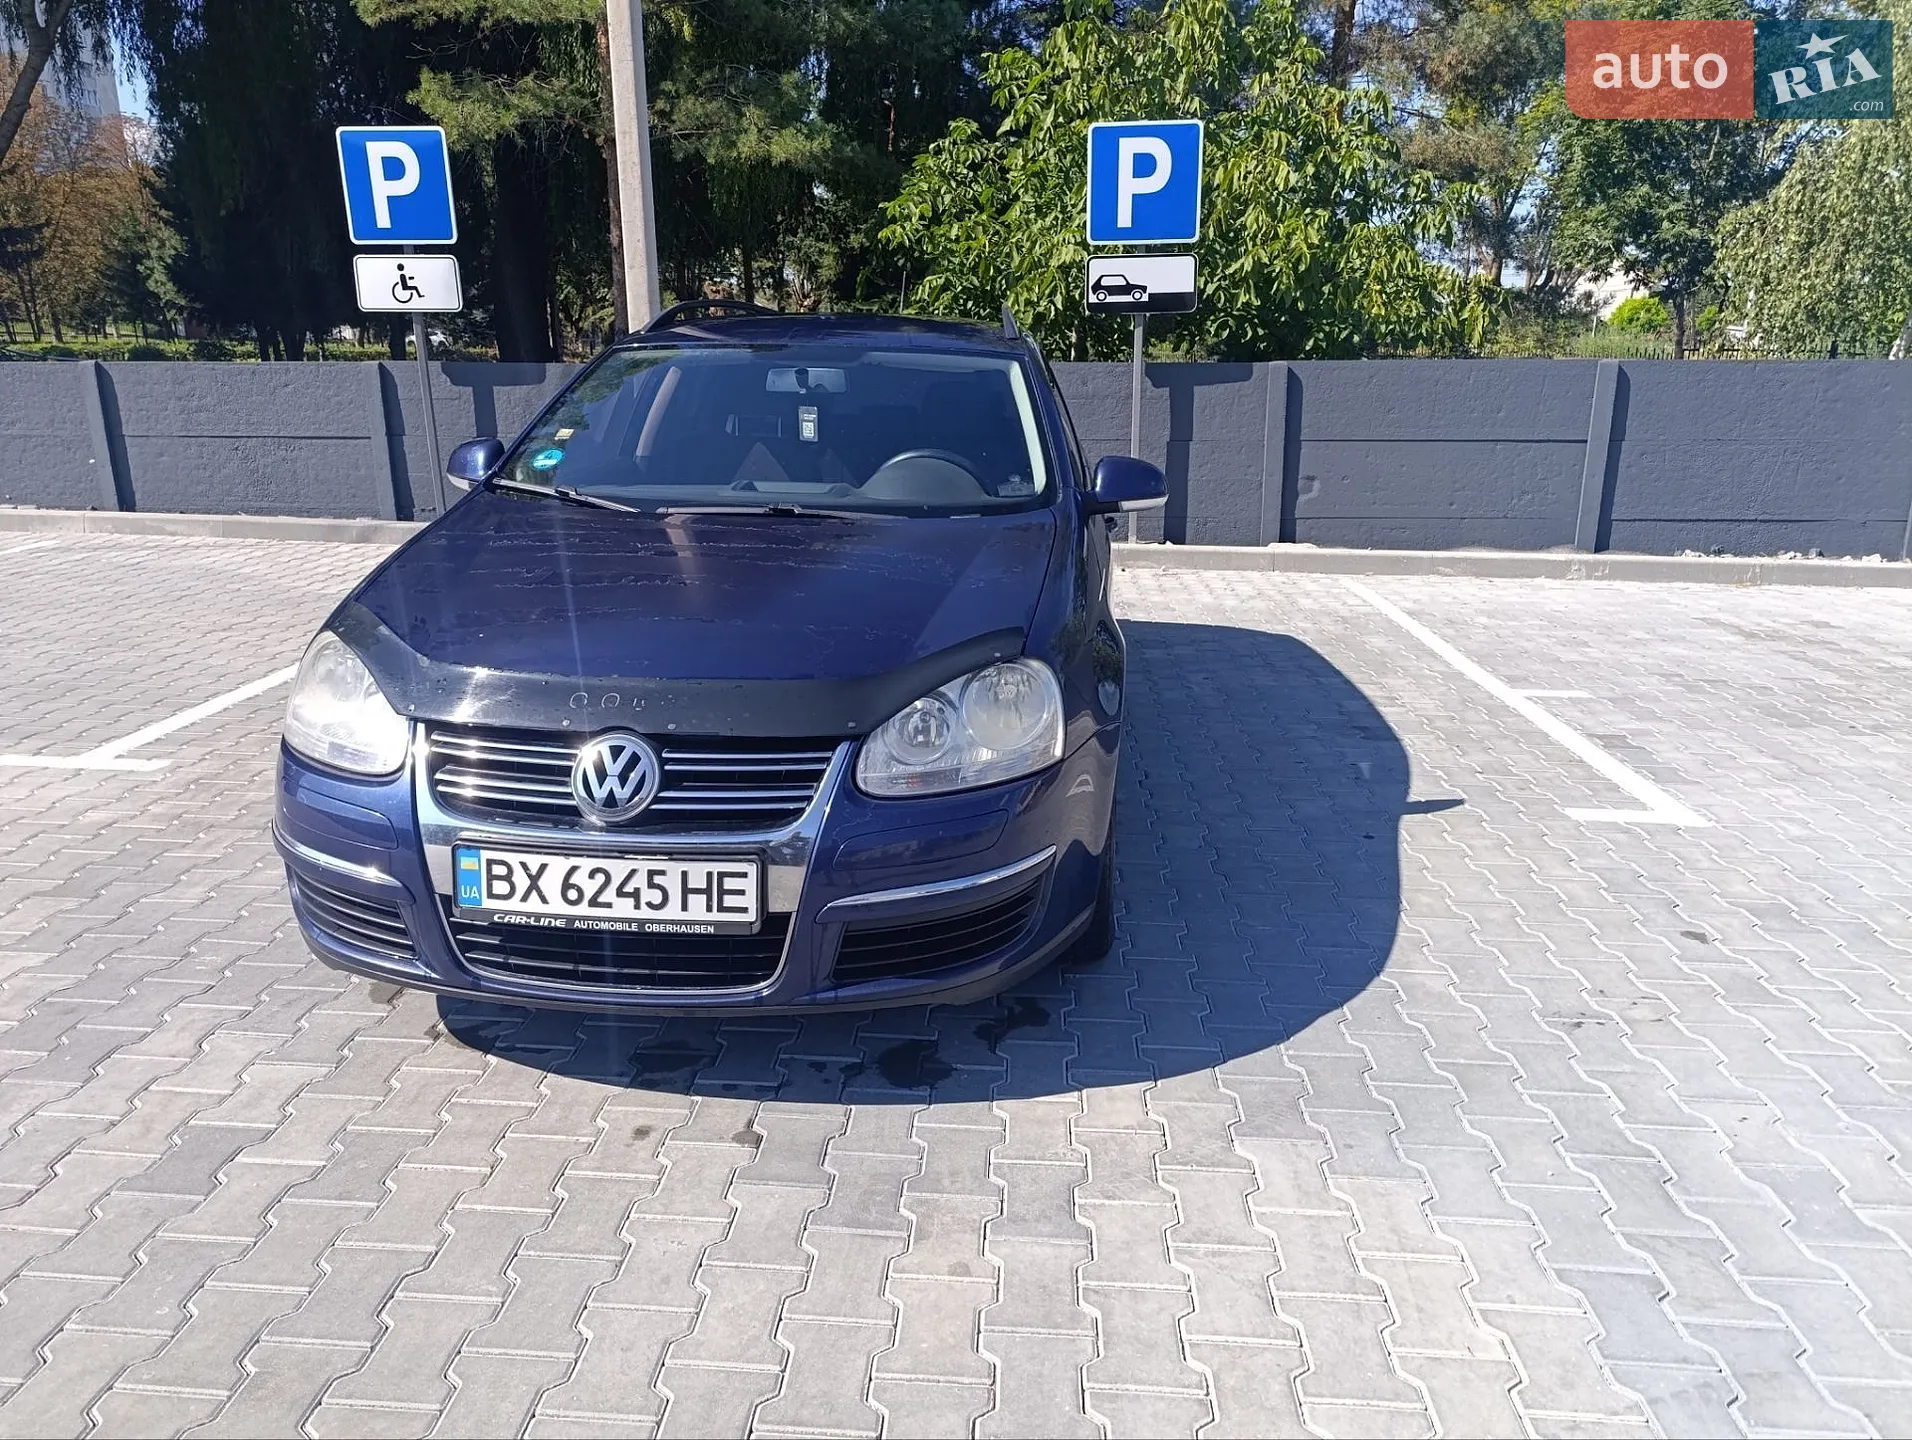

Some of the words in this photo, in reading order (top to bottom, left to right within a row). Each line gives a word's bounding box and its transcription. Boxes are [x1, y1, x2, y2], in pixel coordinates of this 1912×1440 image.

[365, 140, 420, 229] P
[1117, 136, 1172, 228] P
[575, 736, 656, 815] VW
[461, 885, 480, 899] UA
[486, 858, 550, 905] BX
[560, 865, 670, 912] 6245
[680, 869, 749, 914] HE
[573, 919, 639, 932] AUTOMOBILE
[645, 922, 715, 935] OBERHAUSEN
